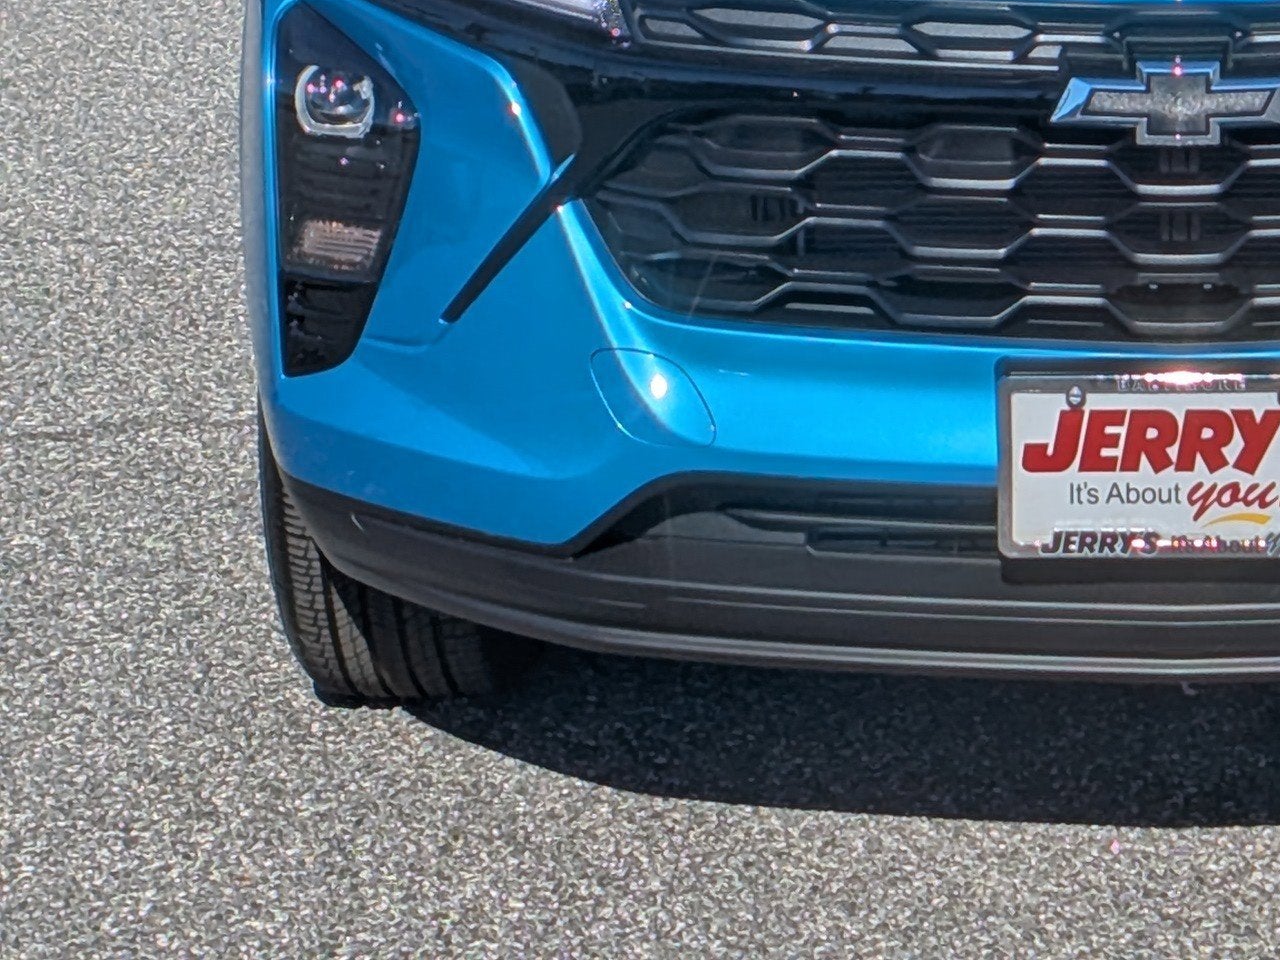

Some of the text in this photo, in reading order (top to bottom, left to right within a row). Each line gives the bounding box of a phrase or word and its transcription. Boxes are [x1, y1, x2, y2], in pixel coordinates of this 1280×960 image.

[1069, 482, 1099, 504] It's
[1106, 482, 1181, 504] About
[1041, 529, 1159, 554] JERRY'S
